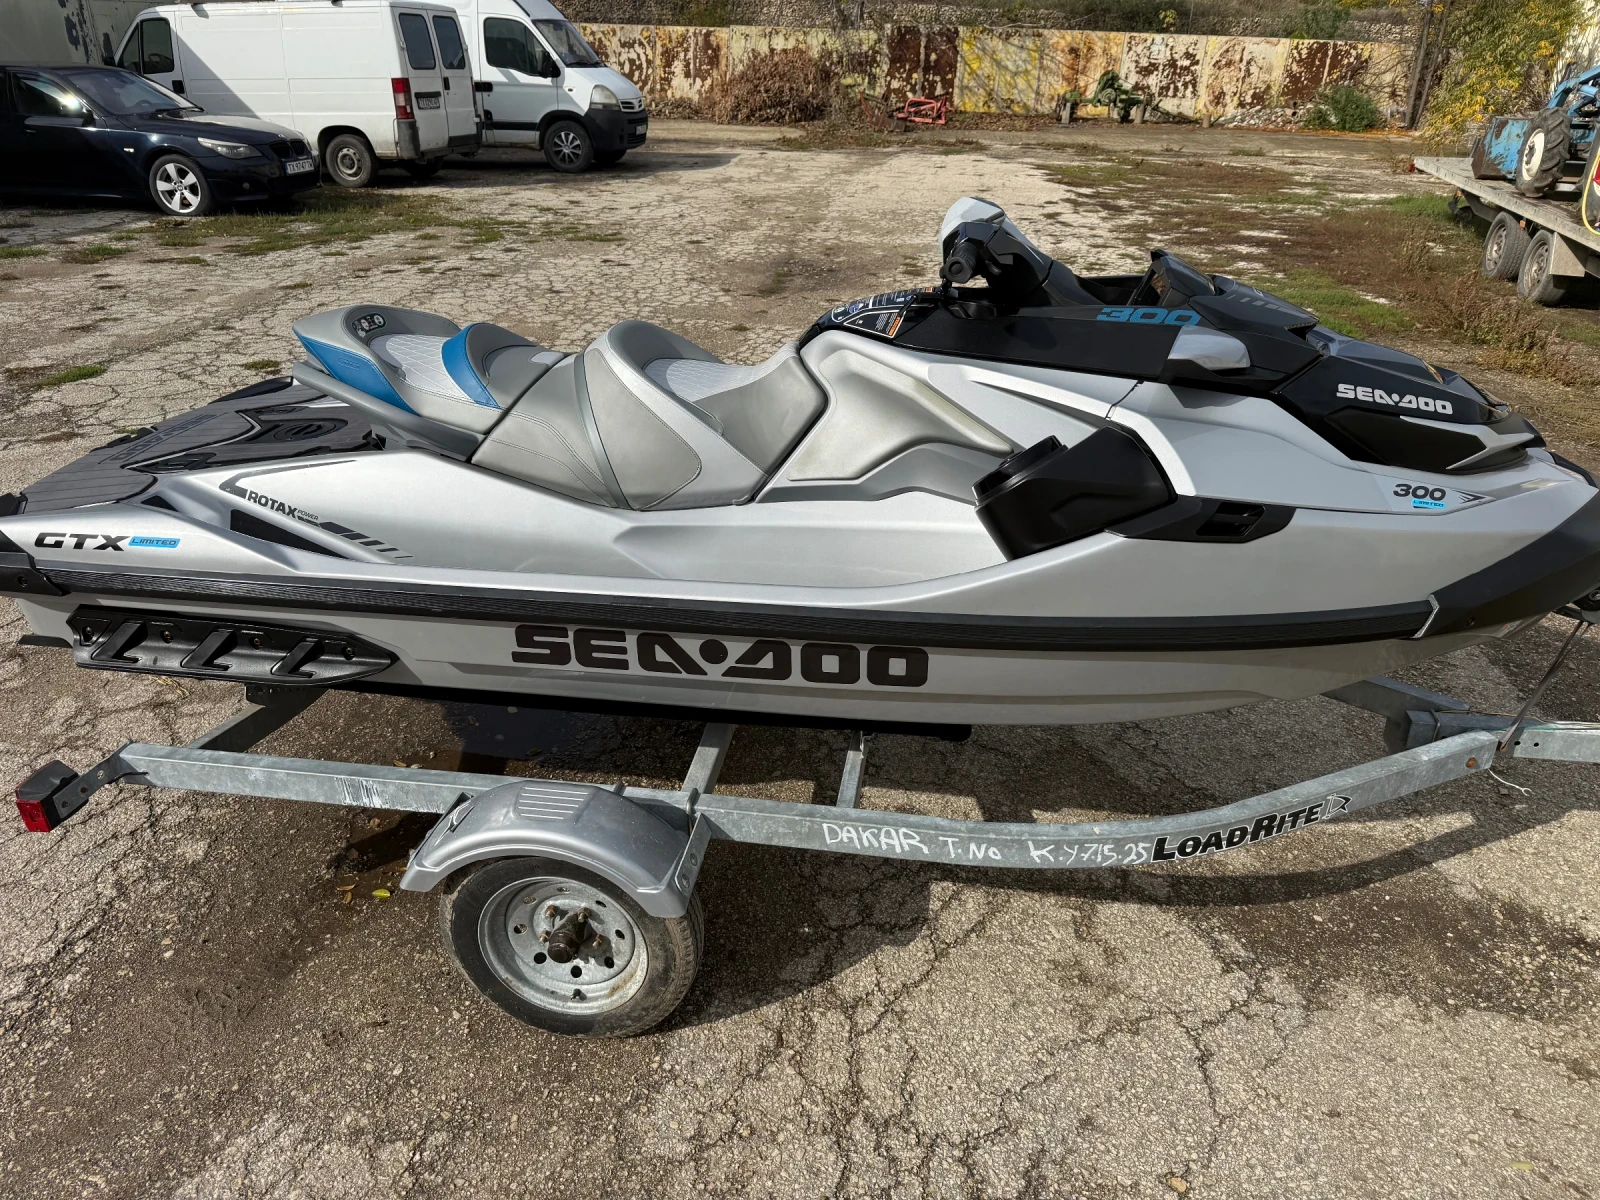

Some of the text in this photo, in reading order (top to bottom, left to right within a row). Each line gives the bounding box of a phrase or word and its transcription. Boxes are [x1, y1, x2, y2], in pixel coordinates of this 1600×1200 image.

[1096, 307, 1201, 326] 300
[1393, 483, 1446, 501] 300
[247, 490, 319, 521] ROTAX POWER
[34, 532, 177, 552] GTX LIMITED
[821, 822, 929, 855] DAKAR
